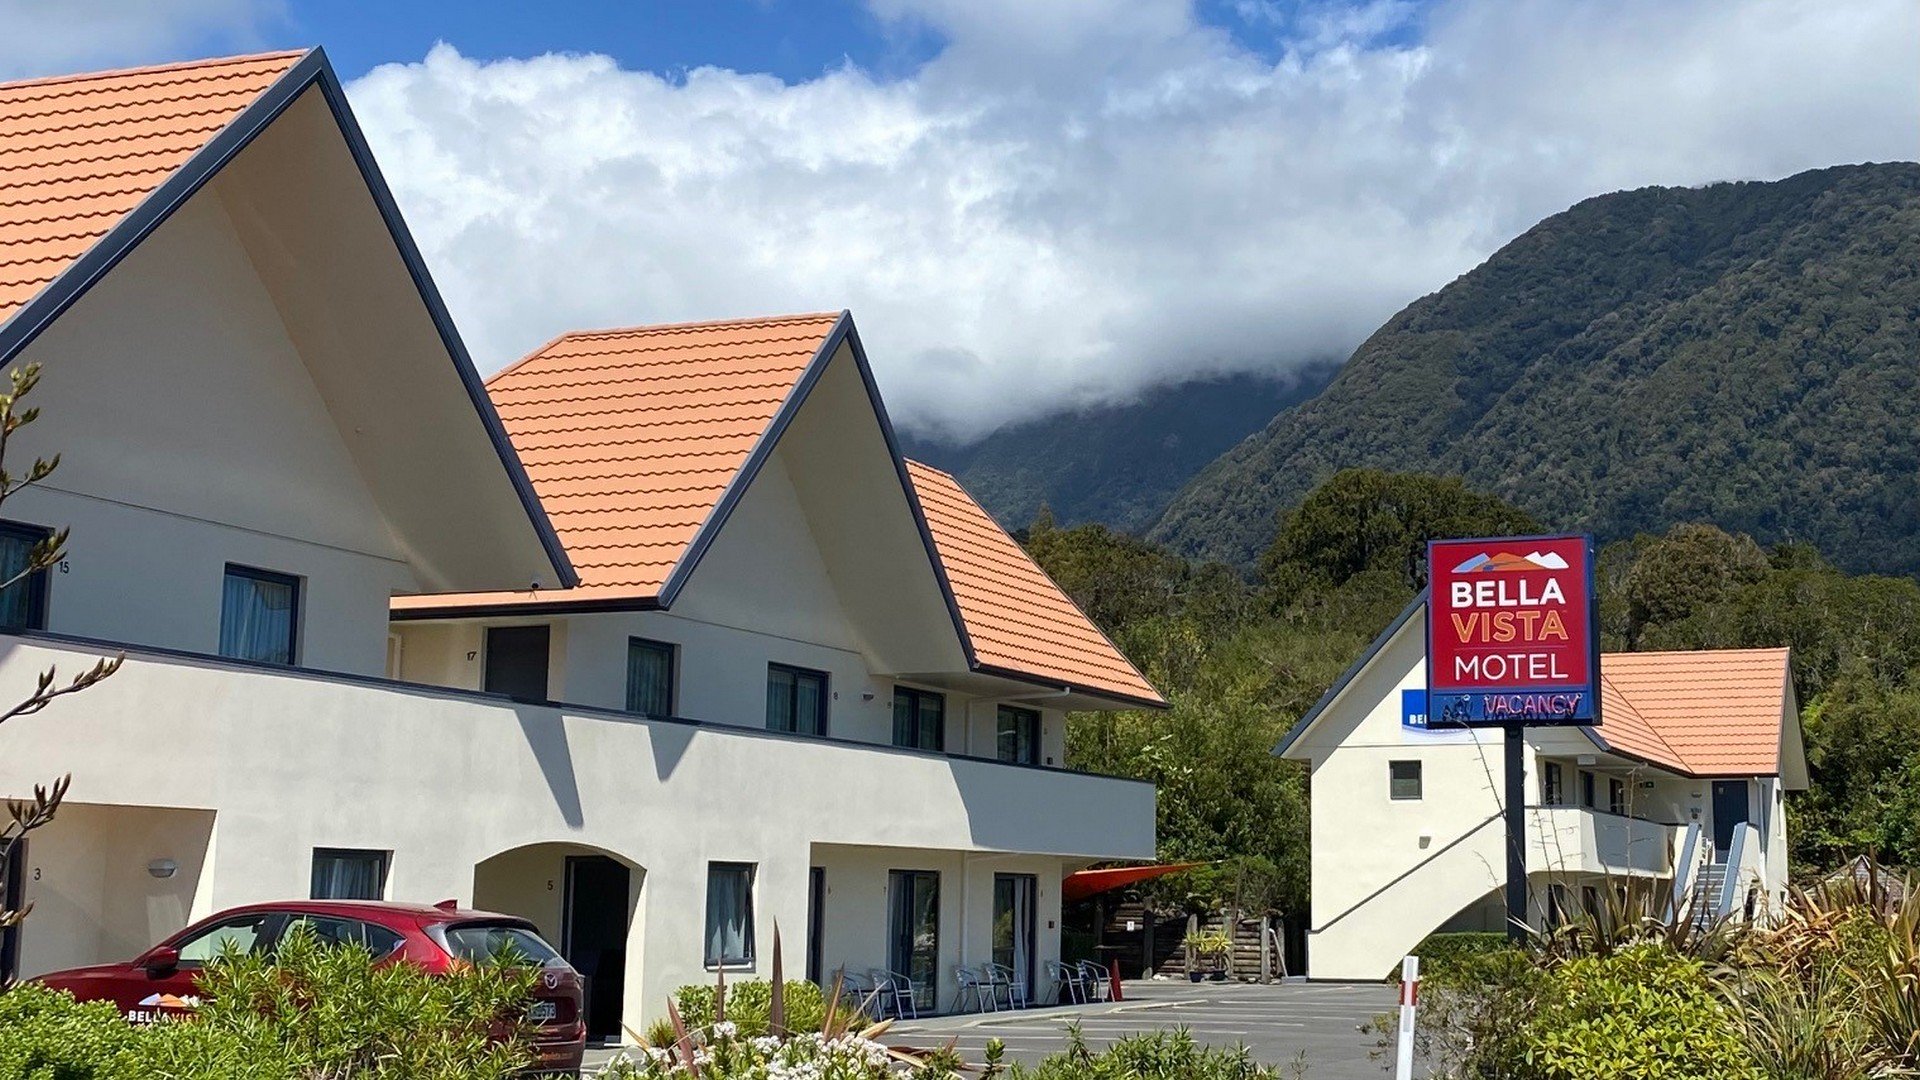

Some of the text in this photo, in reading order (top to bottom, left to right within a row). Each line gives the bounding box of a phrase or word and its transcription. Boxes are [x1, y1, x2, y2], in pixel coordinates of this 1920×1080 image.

[60, 561, 69, 574] 15
[1451, 577, 1566, 608] BELLA
[1451, 609, 1569, 643] VISTA
[467, 651, 477, 661] 17
[1455, 653, 1569, 681] MOTEL
[1484, 692, 1580, 715] VACANCY
[34, 867, 41, 881] 3
[547, 880, 554, 891] 5
